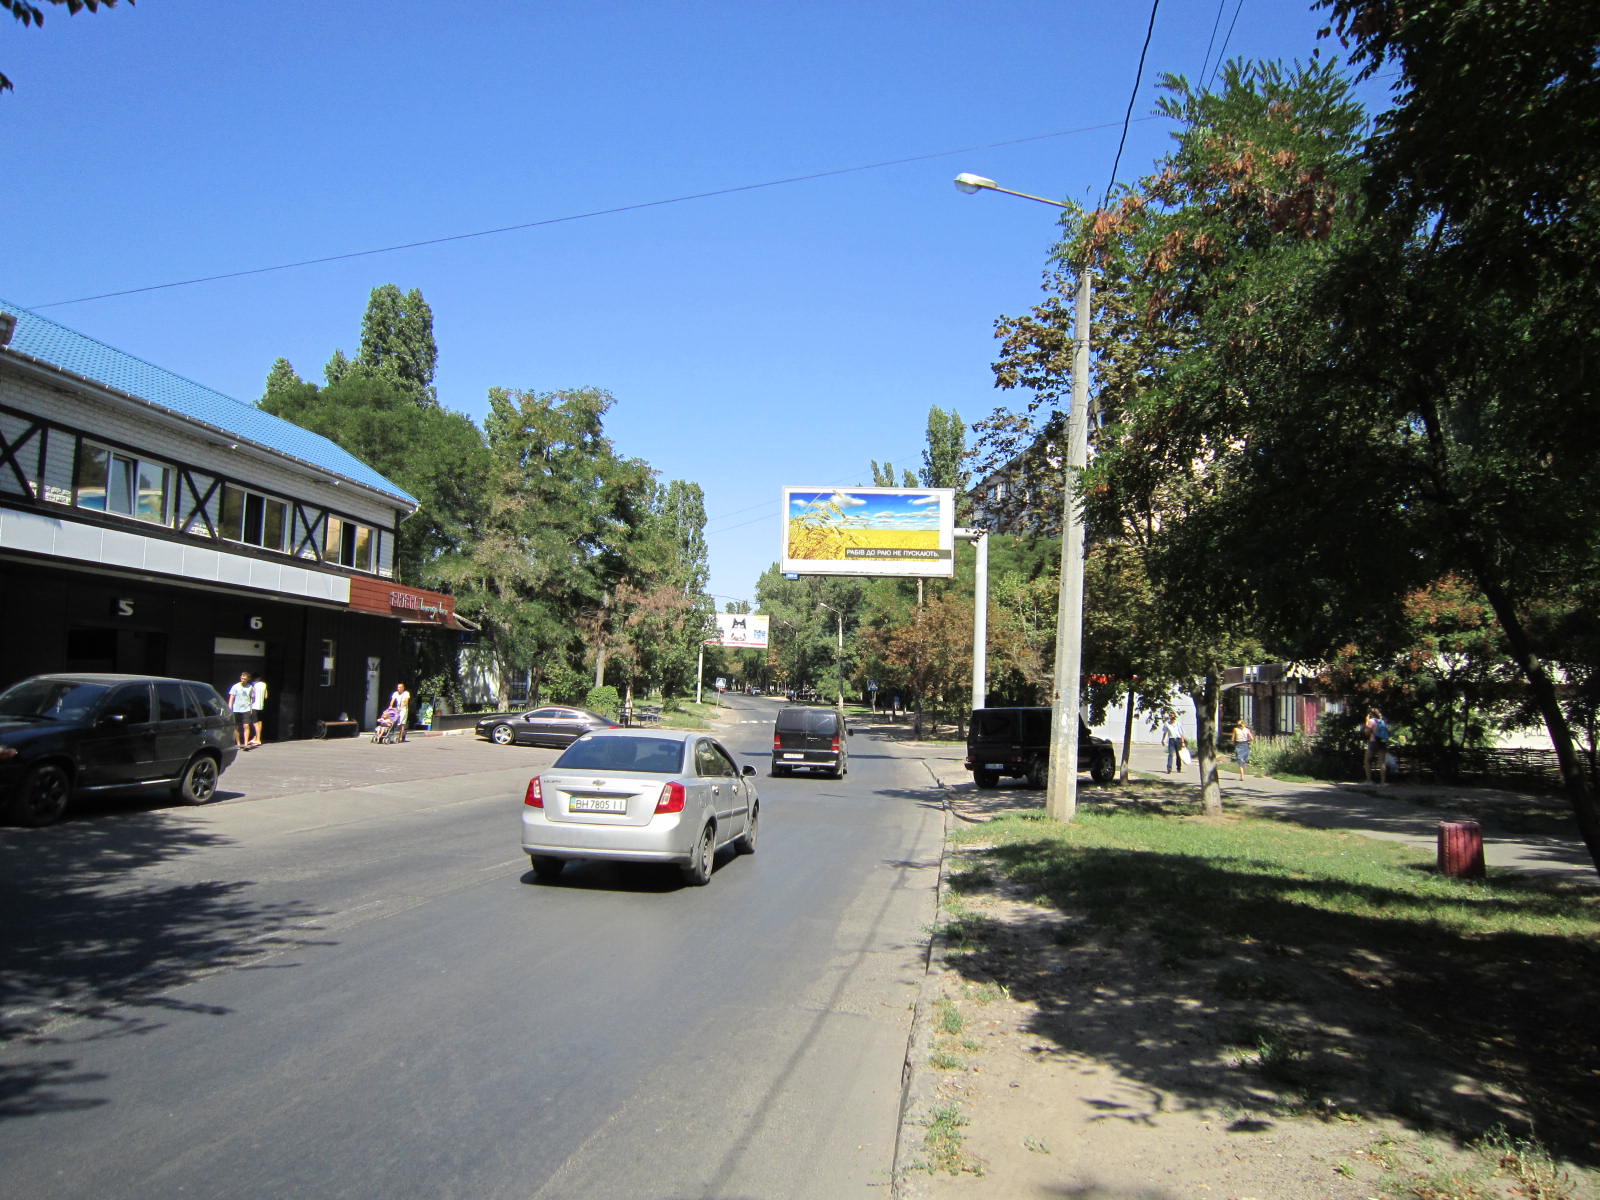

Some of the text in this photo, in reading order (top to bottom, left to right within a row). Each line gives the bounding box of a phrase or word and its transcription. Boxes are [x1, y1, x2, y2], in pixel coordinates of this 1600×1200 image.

[118, 598, 135, 616] 5
[250, 616, 263, 630] 6
[576, 799, 589, 809] BH
[590, 800, 610, 809] 7805
